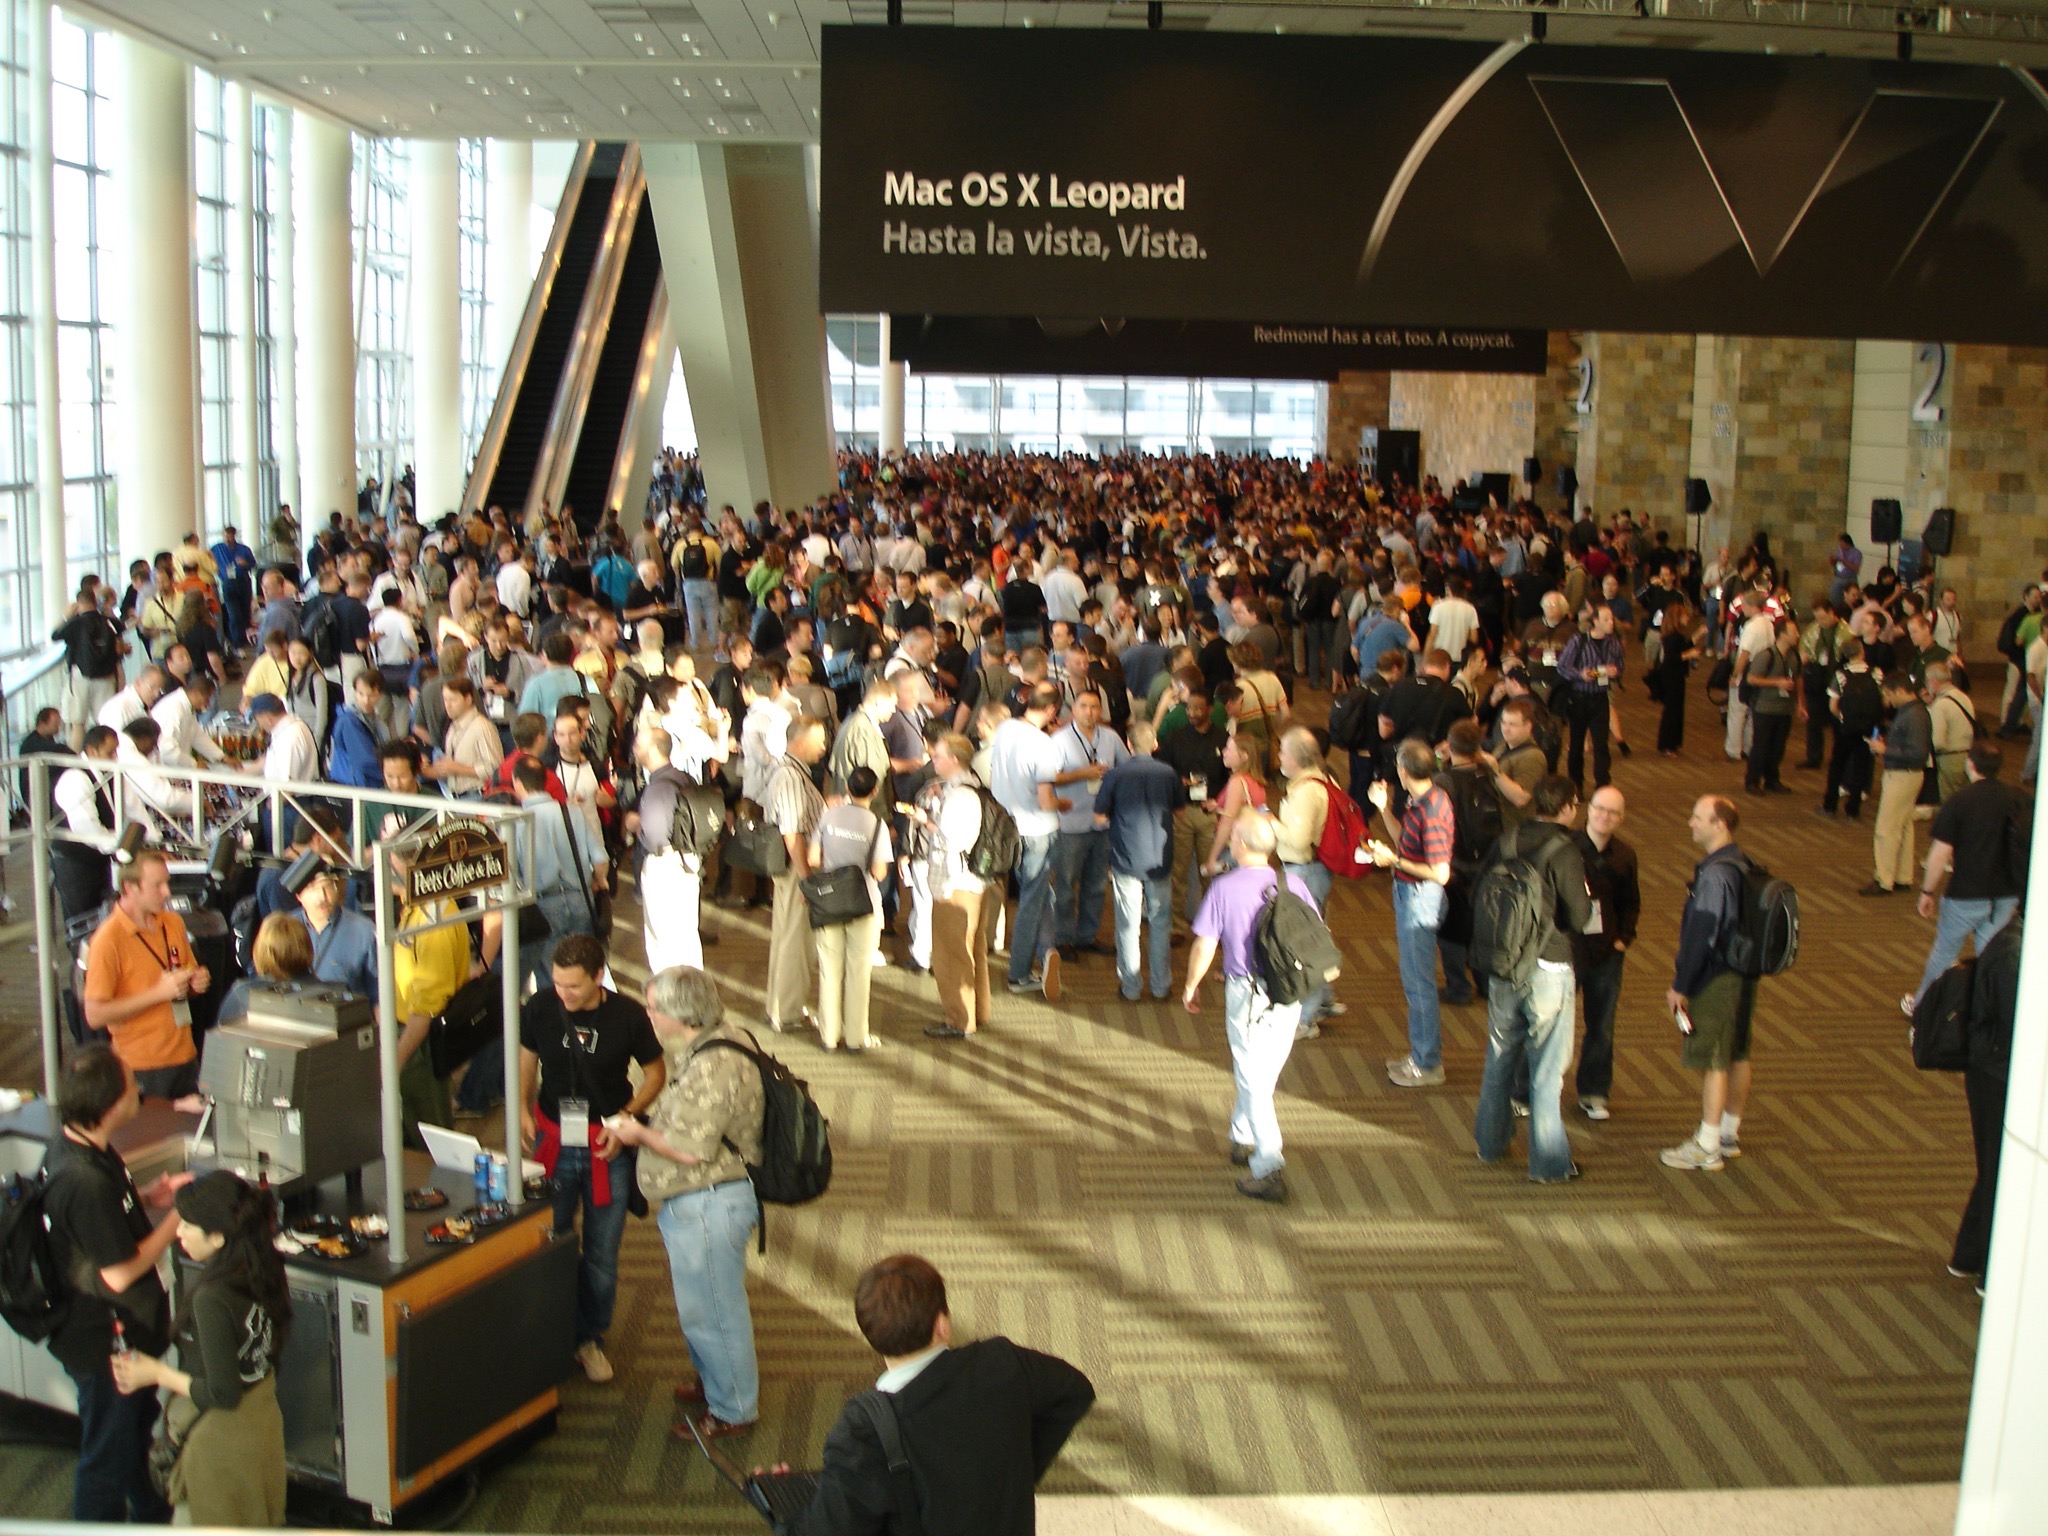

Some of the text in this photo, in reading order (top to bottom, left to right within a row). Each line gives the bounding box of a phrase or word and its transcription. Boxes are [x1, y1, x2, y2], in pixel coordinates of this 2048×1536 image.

[884, 171, 1185, 217] Mac OS X Leopard
[883, 220, 1207, 261] Hasta la vista, Vista.
[1253, 325, 1328, 344] Redmond
[1332, 326, 1359, 345] has
[1362, 330, 1371, 345] a
[1374, 329, 1400, 347] cat,
[1404, 330, 1434, 347] too.
[1437, 329, 1448, 347] A
[1911, 342, 1946, 421] 2
[443, 860, 475, 890] Coffee
[482, 852, 503, 878] Tea
